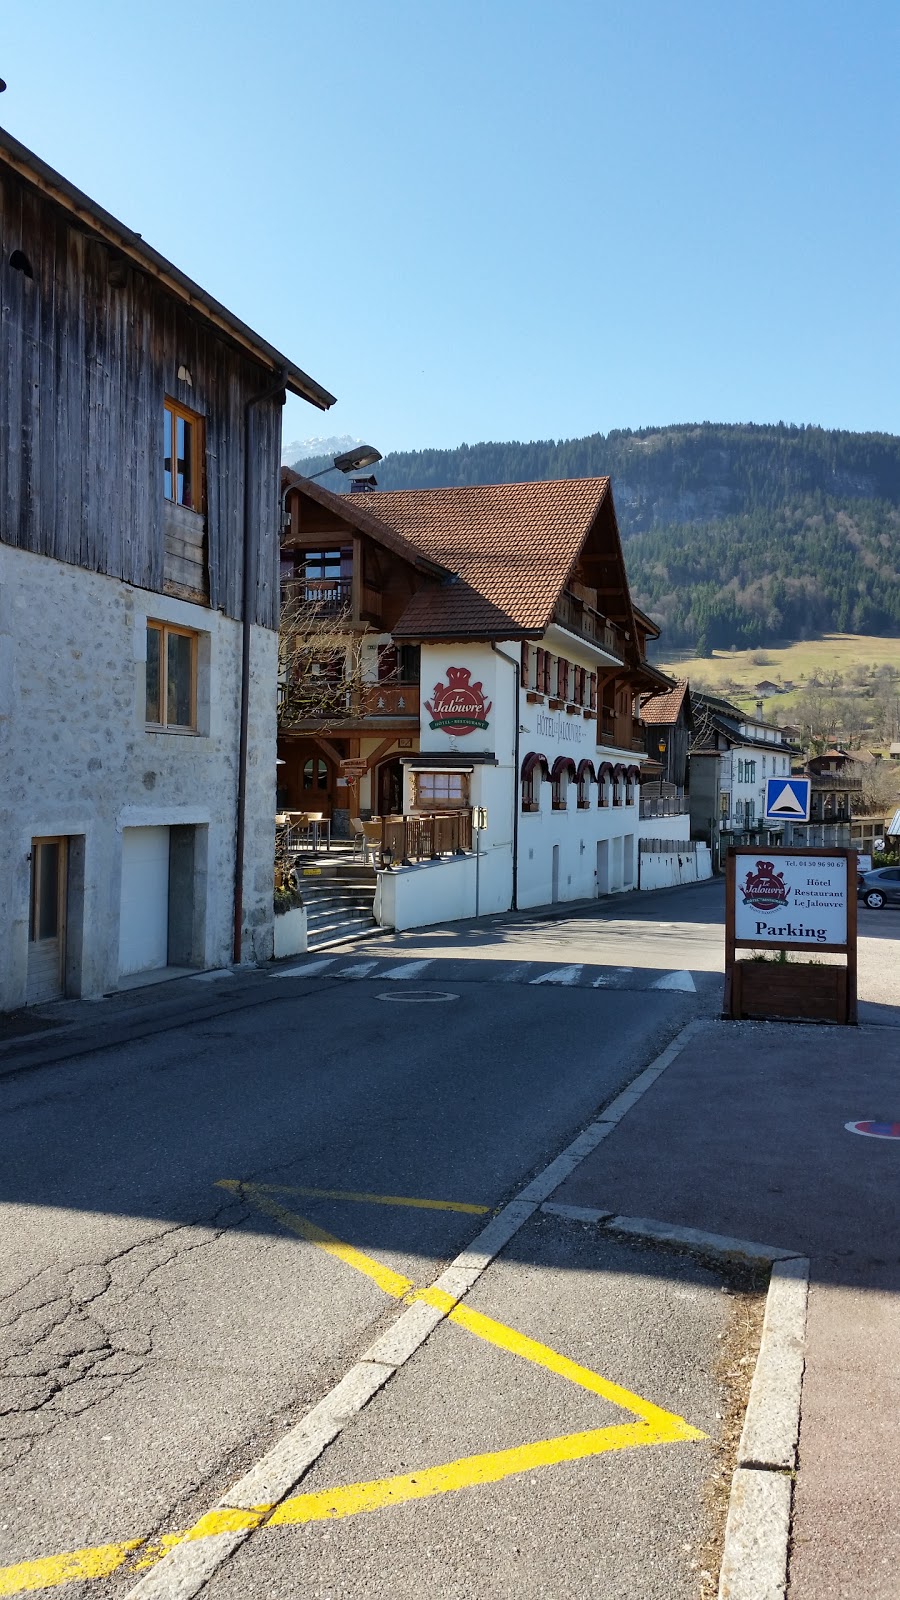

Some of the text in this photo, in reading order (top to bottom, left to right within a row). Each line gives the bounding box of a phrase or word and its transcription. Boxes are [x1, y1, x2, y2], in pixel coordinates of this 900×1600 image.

[434, 700, 482, 712] Jalouvre
[454, 719, 485, 727] RESTAURANT
[536, 710, 554, 737] HÔTEL
[806, 878, 831, 886] Hôtel
[745, 885, 784, 894] Jalouvre
[794, 889, 843, 898] Restaurant
[806, 899, 843, 908] Jalouvre
[755, 921, 827, 942] Parking
